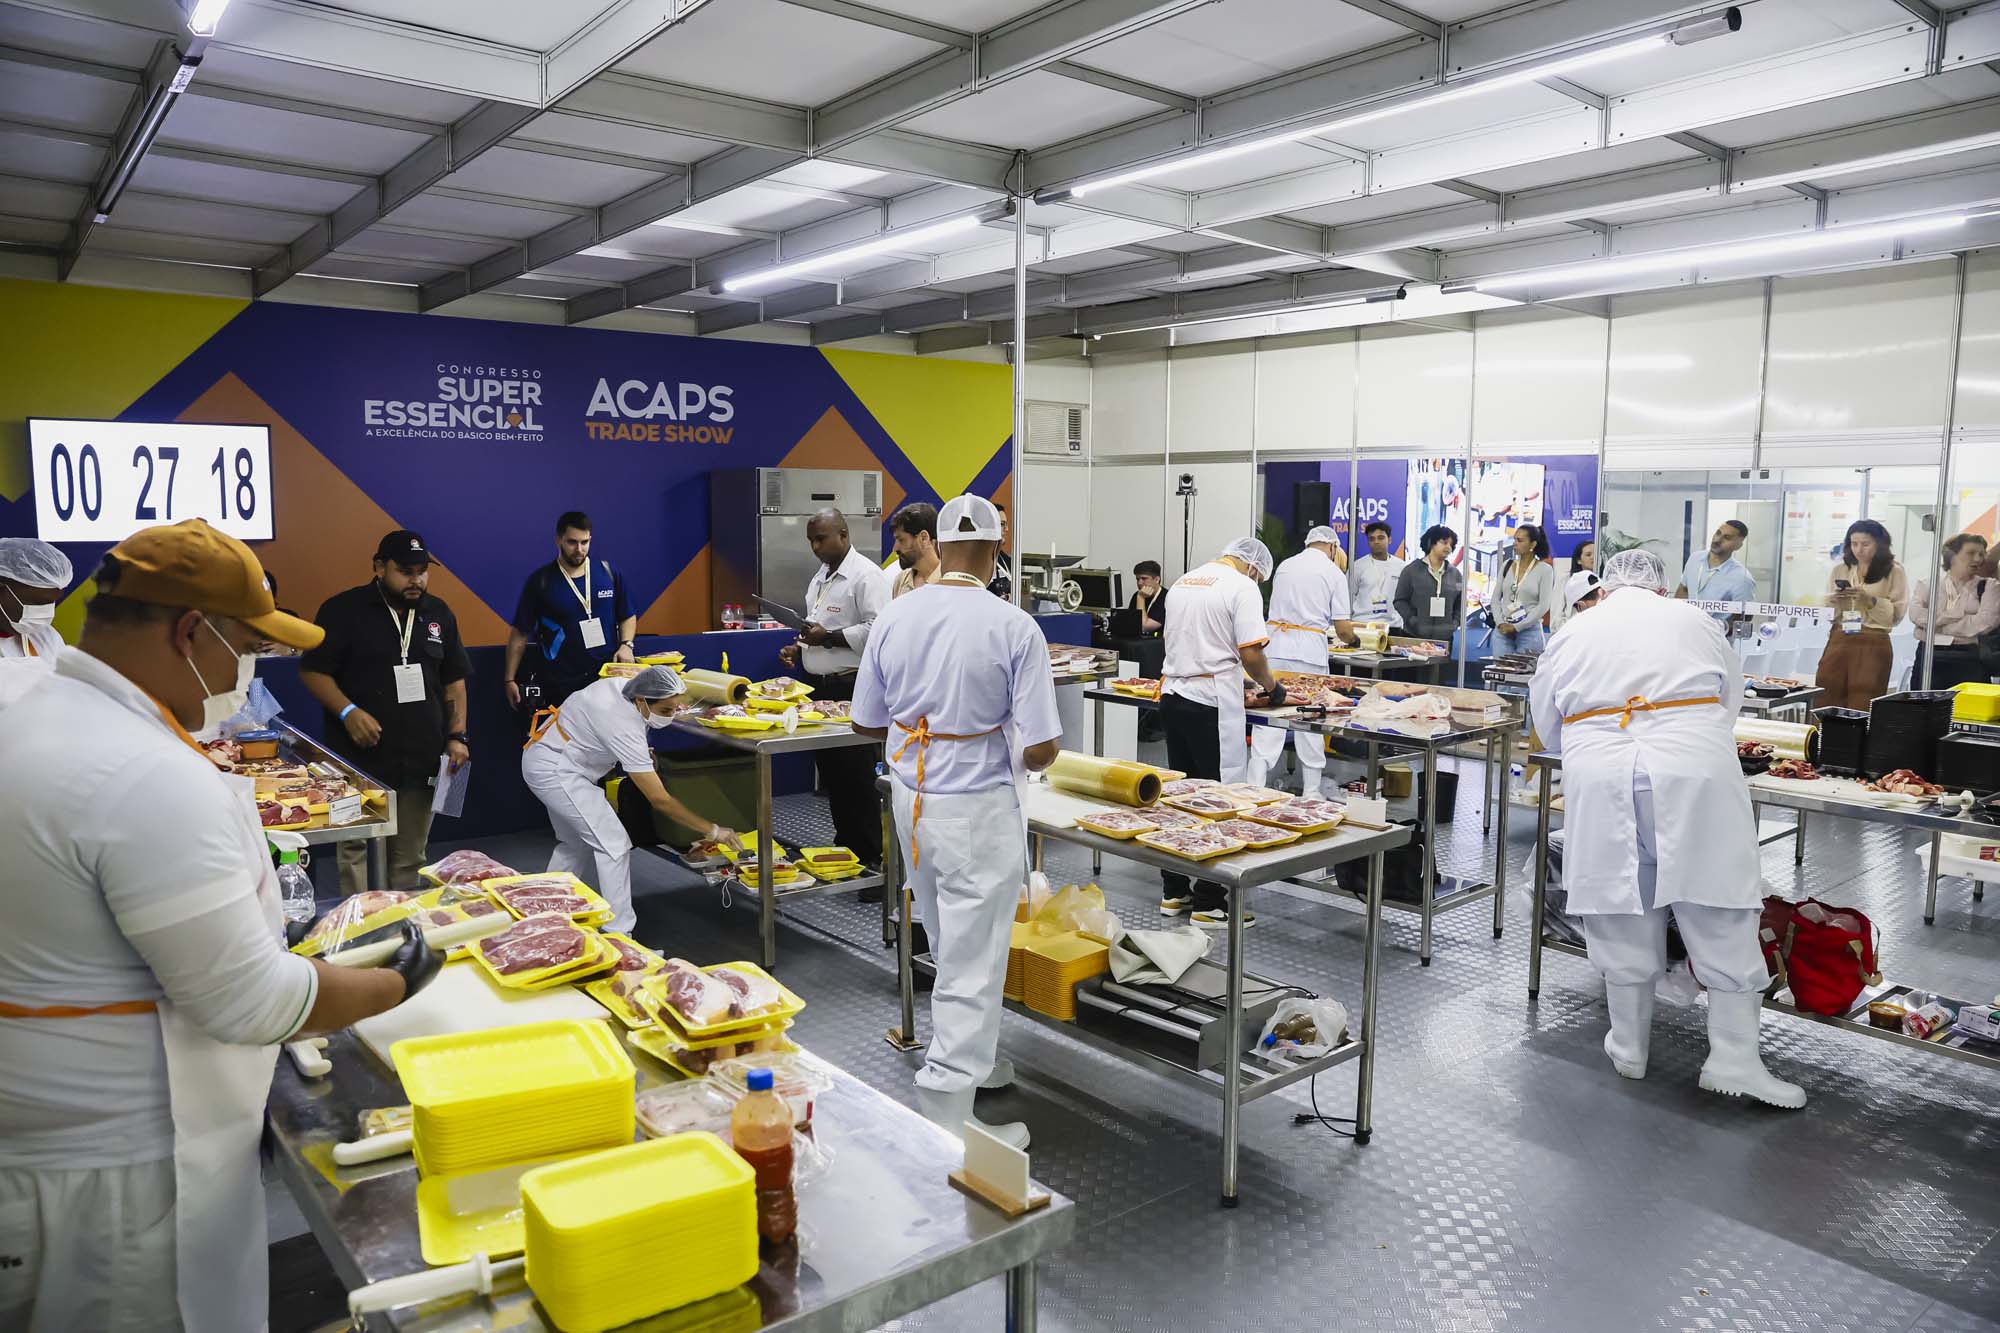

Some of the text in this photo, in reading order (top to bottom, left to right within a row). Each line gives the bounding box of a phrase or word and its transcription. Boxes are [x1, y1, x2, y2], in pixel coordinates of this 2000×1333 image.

[437, 364, 542, 378] CONGRESSO
[438, 376, 543, 406] SUPER
[585, 377, 735, 423] ACAPS
[364, 400, 544, 431] ESSENCIAL
[366, 429, 373, 437] A
[375, 428, 439, 438] EXCELÊNCIA
[441, 431, 456, 439] DO
[585, 421, 735, 445] TRADE SHOW
[51, 443, 256, 521] 00 27 18
[1571, 509, 1593, 520] SUPER
[1687, 600, 1729, 612] PURRE
[1760, 604, 1820, 618] EMPURRE
